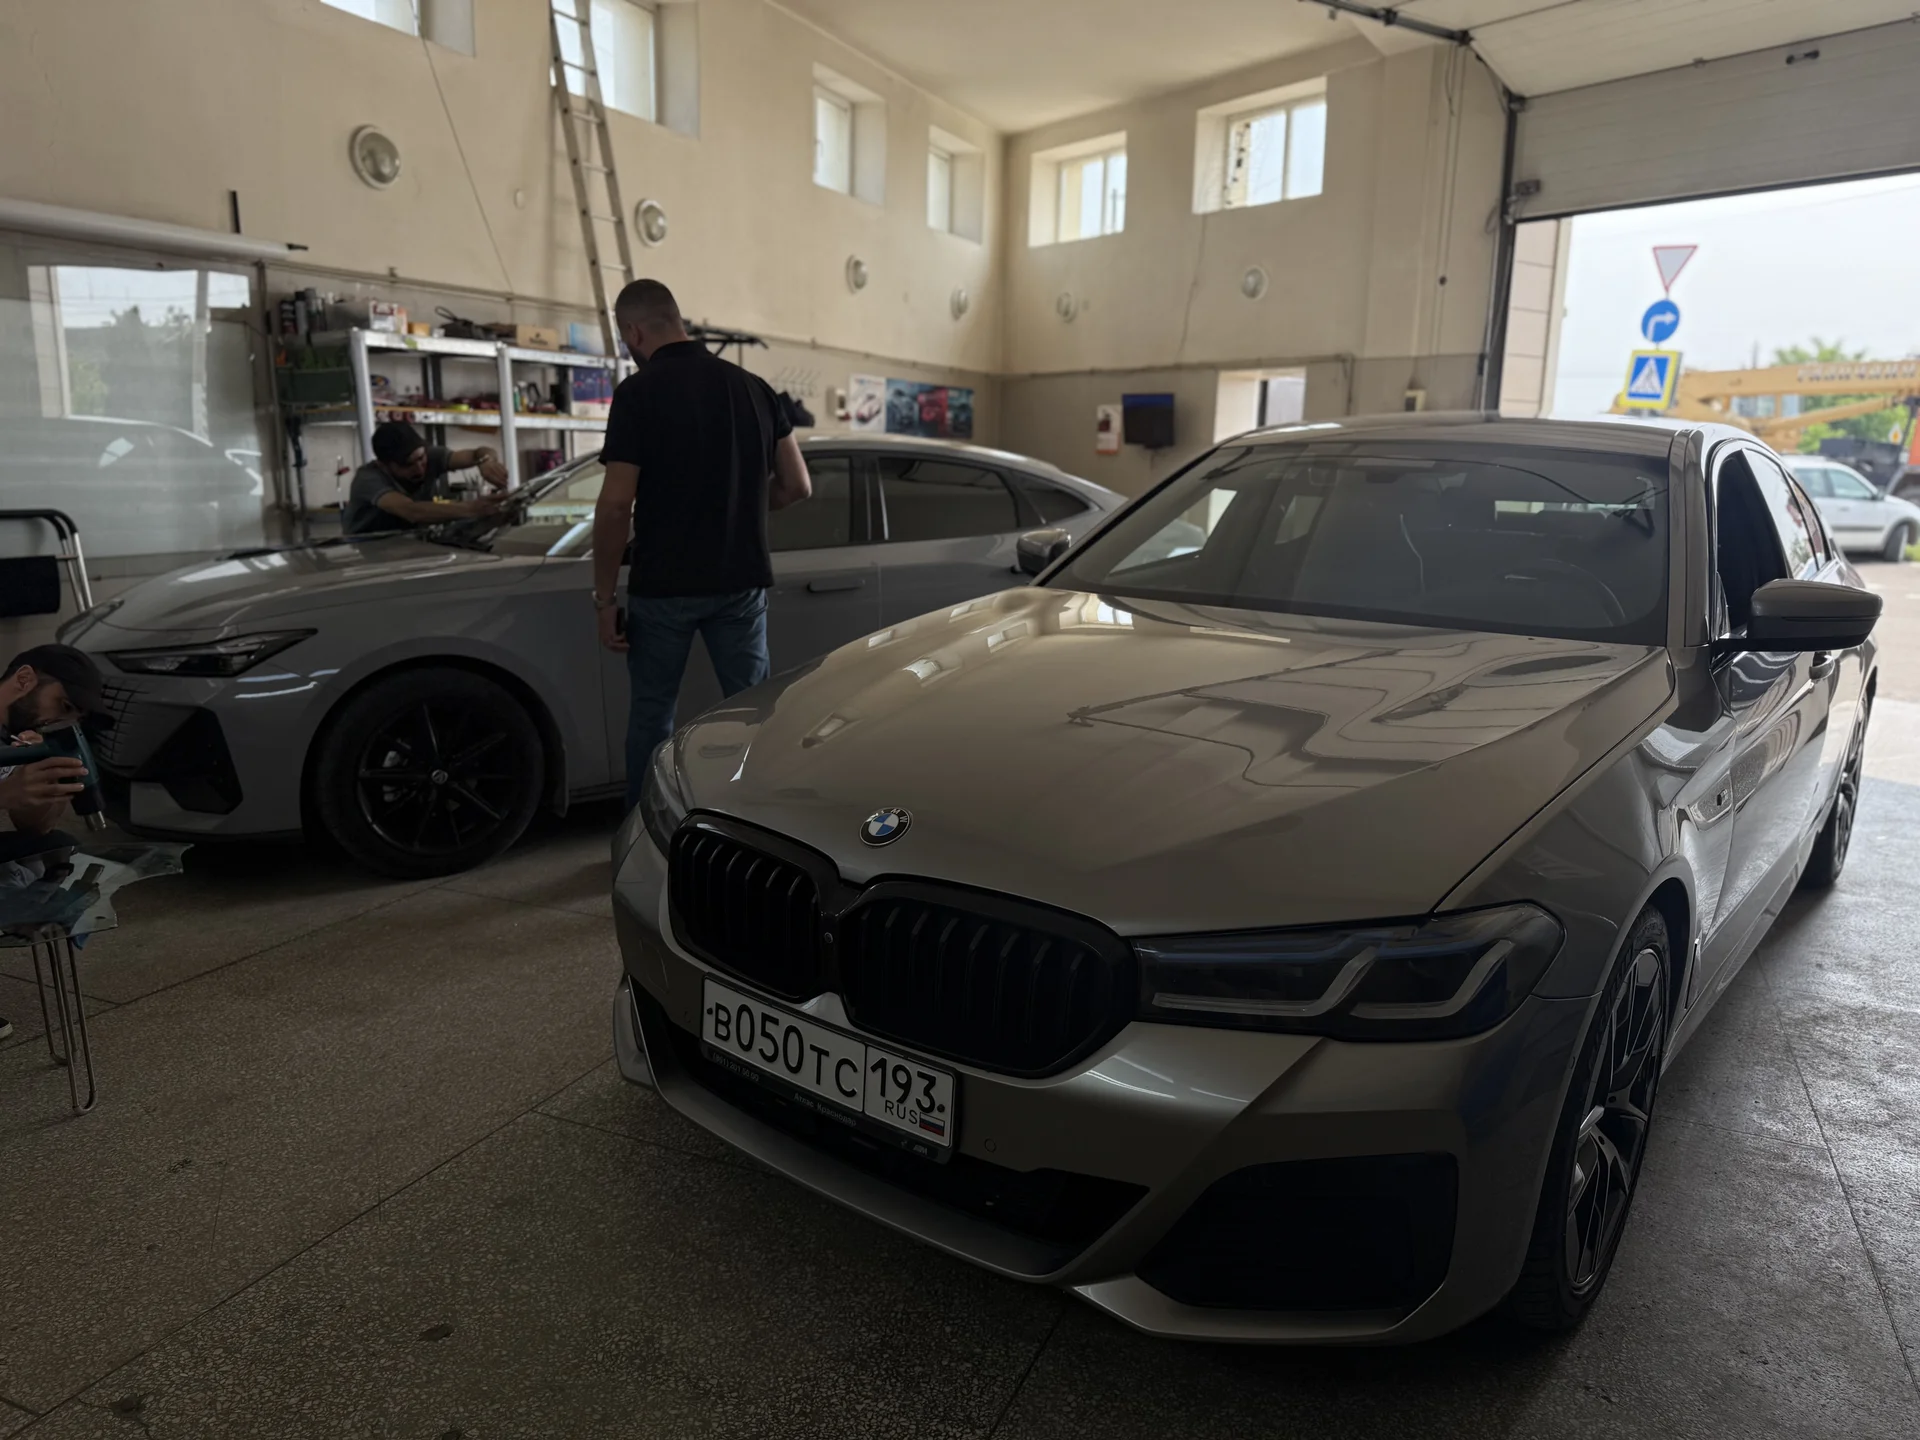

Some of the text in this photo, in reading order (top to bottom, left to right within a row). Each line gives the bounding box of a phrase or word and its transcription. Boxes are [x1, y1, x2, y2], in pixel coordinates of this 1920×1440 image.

[714, 1002, 937, 1114] В050ТС 193
[816, 1102, 857, 1127] Краснодар
[884, 1100, 918, 1124] RUS
